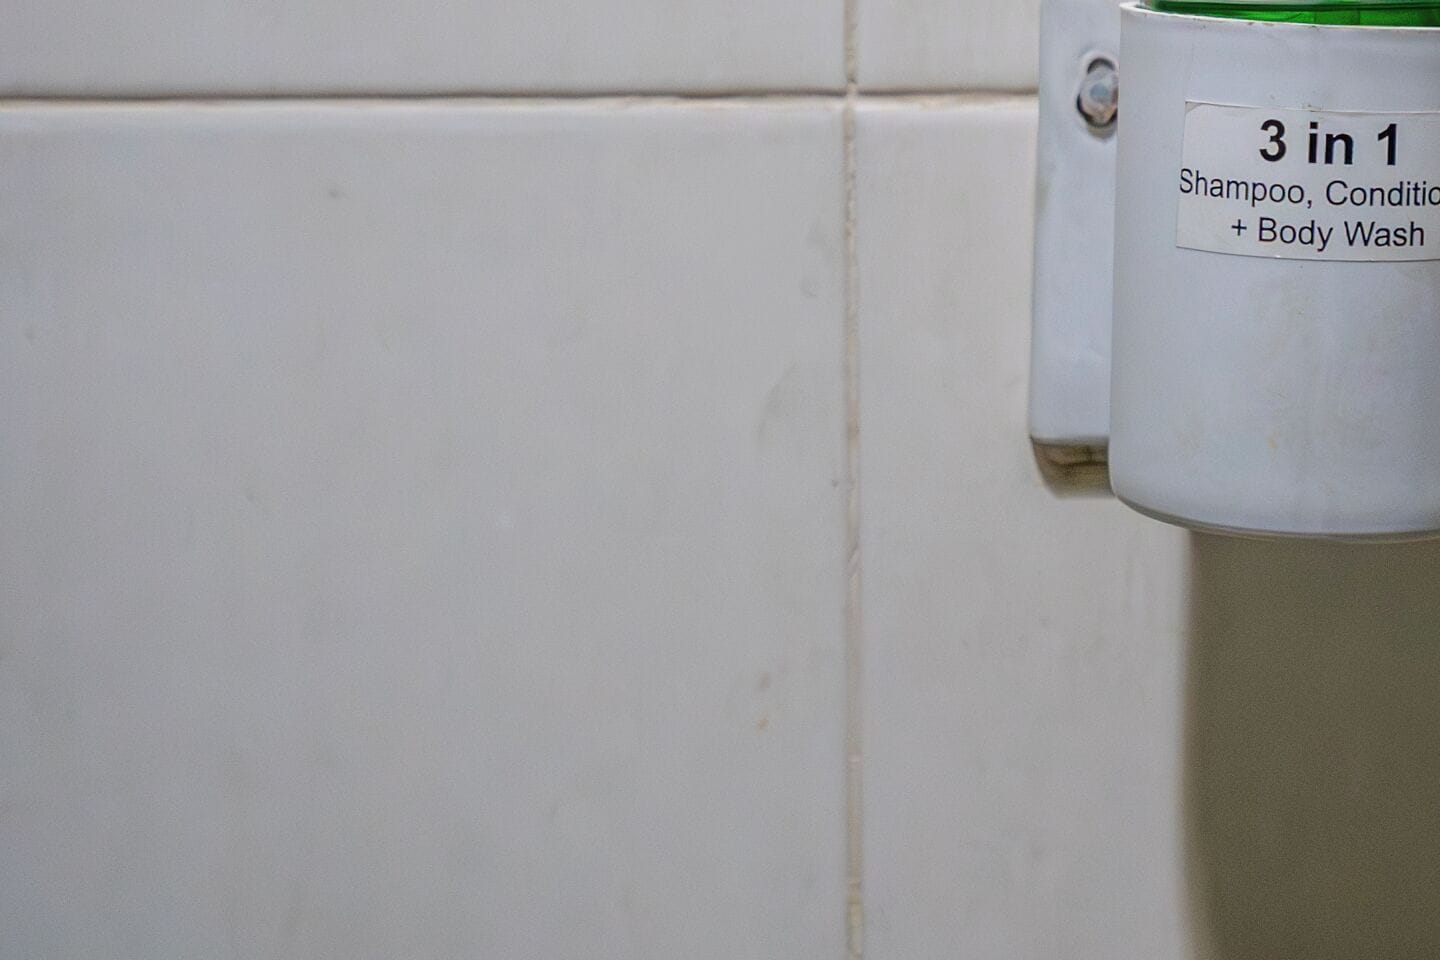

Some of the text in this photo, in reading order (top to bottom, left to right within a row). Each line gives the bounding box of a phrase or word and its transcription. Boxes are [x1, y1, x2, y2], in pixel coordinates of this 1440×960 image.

[1258, 118, 1398, 166] 3 in 1
[1179, 167, 1313, 209] Shampoo,
[1231, 216, 1425, 253] + Body Wash
